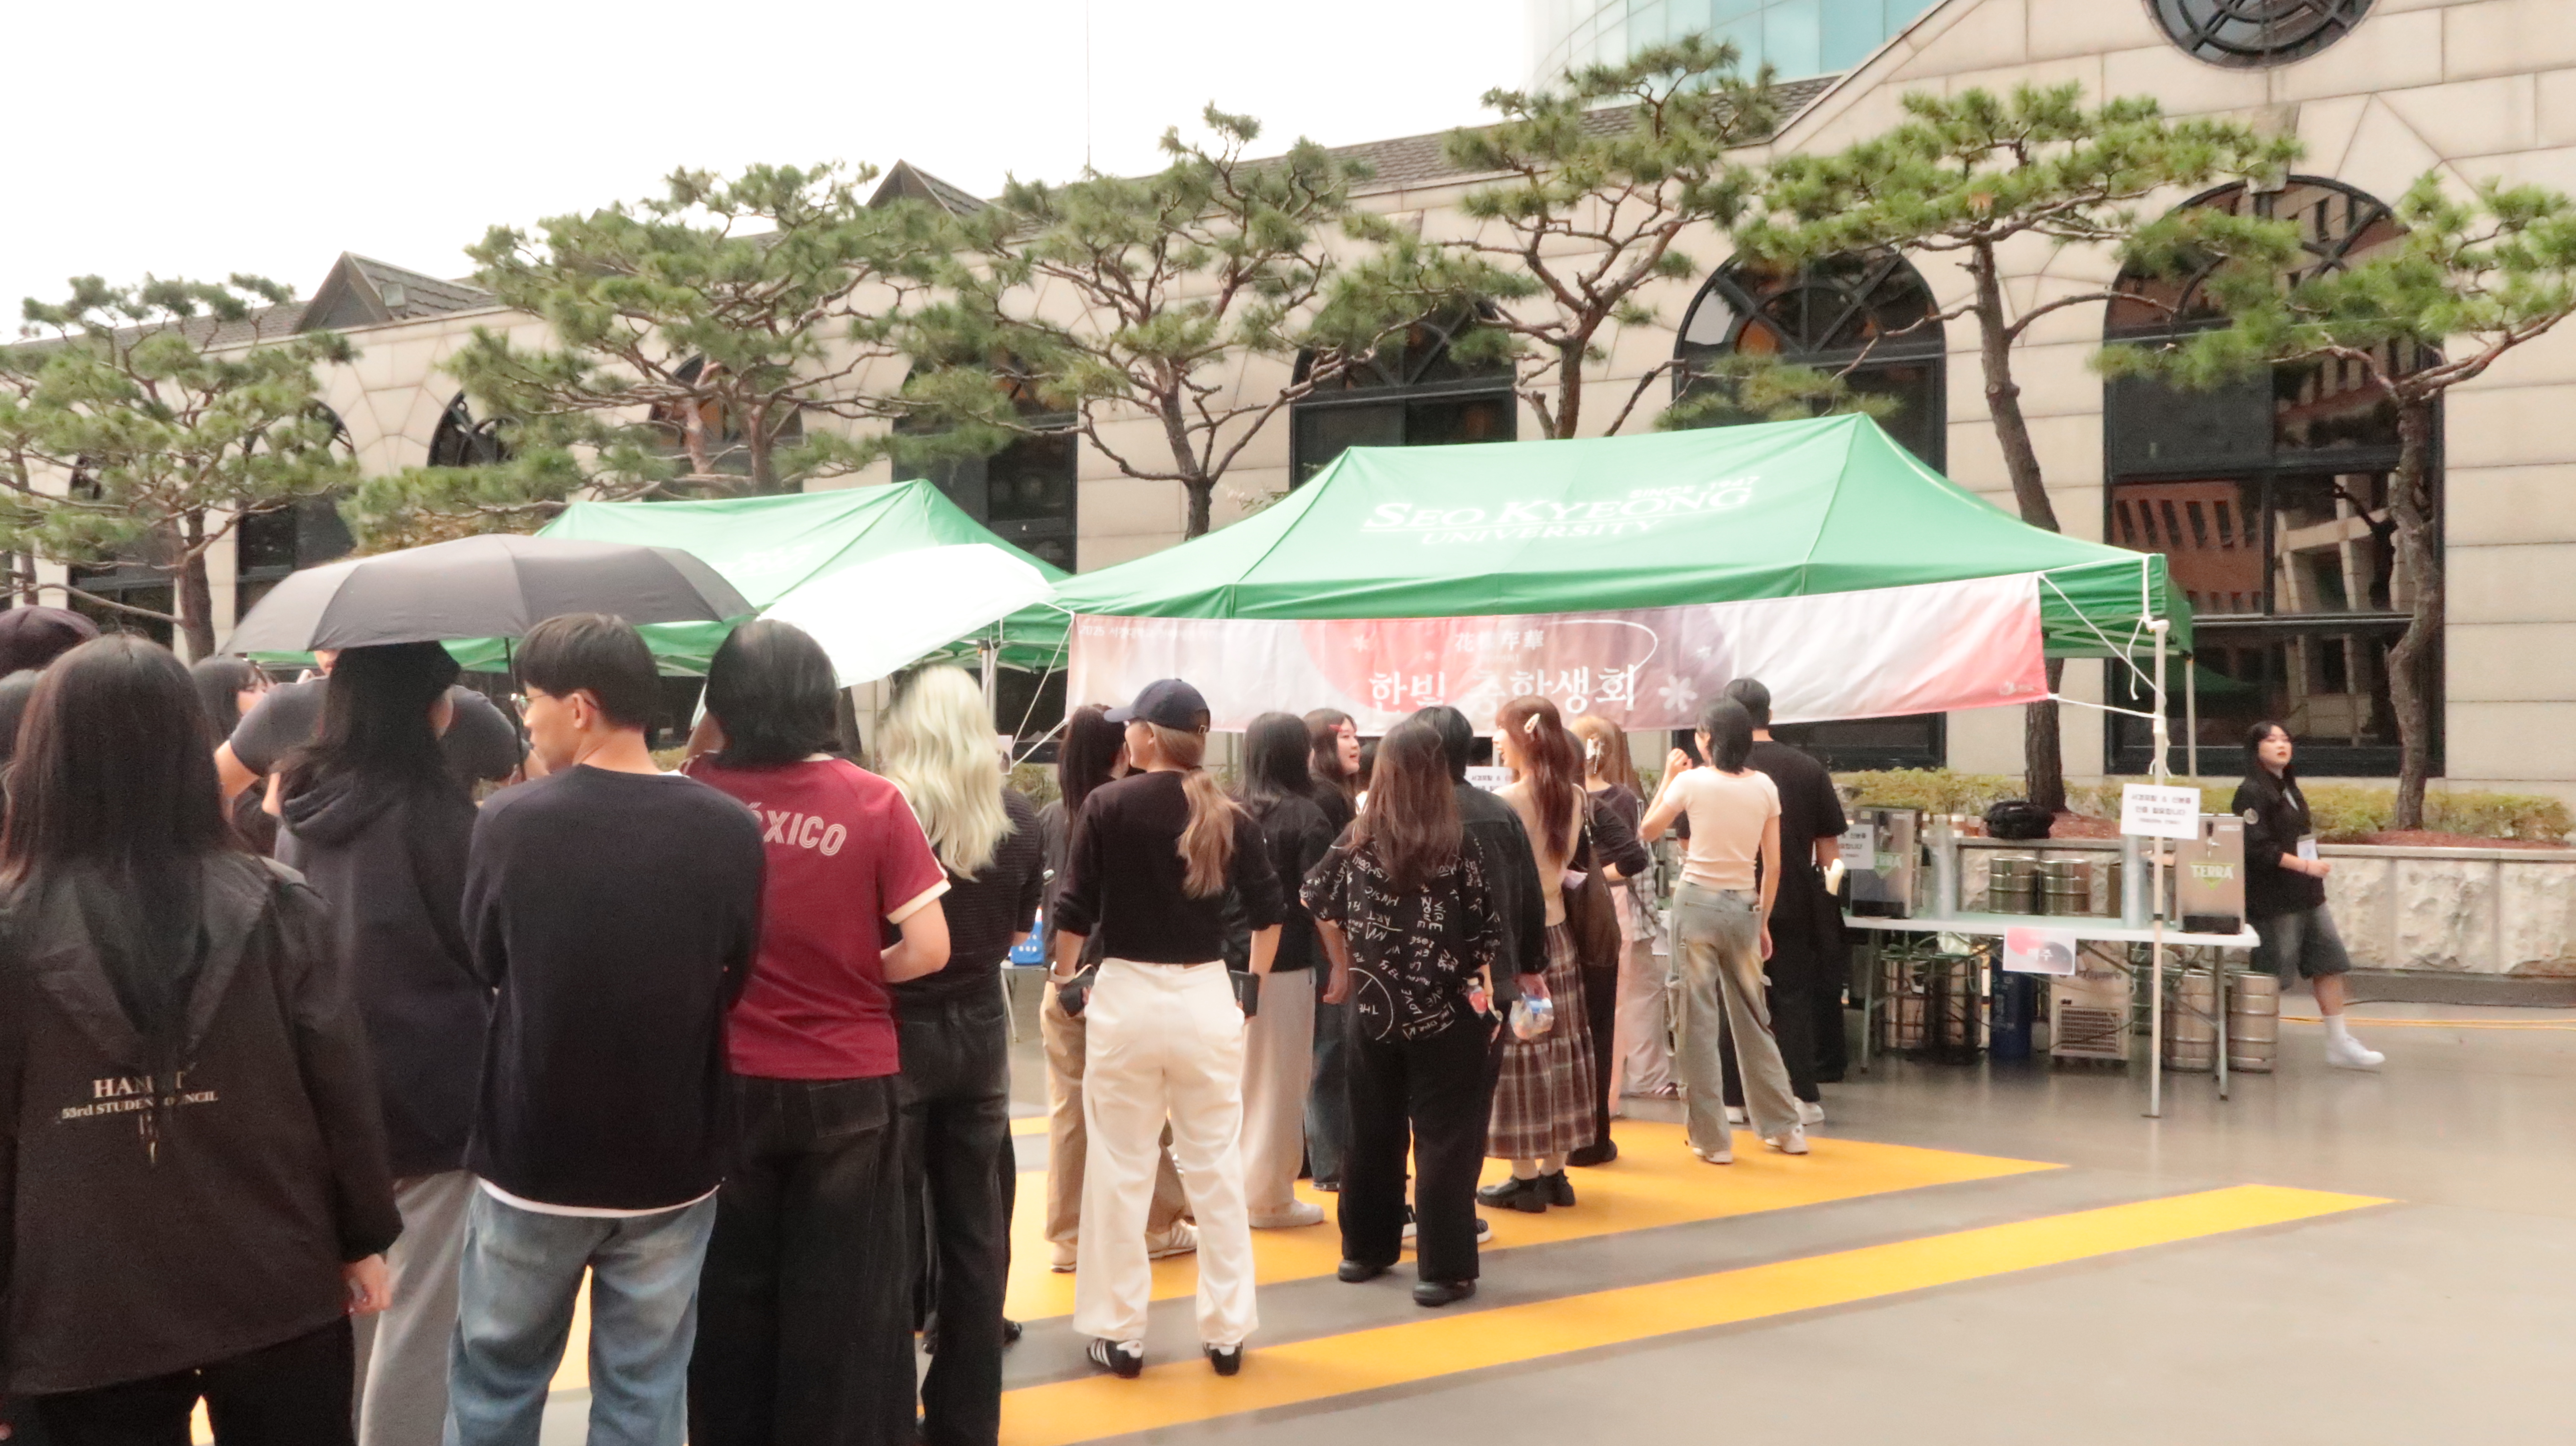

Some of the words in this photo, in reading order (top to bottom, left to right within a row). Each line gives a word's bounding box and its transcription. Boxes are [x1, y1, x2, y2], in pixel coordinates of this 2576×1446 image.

[1364, 502, 1486, 528] SEO
[1493, 487, 1753, 524] KYEONG
[1421, 518, 1663, 545] UNIVERSITY
[1079, 625, 1105, 635] 2025
[2190, 864, 2234, 880] TERRA
[62, 1104, 93, 1119] 53rd
[96, 1098, 154, 1113] STUDEN
